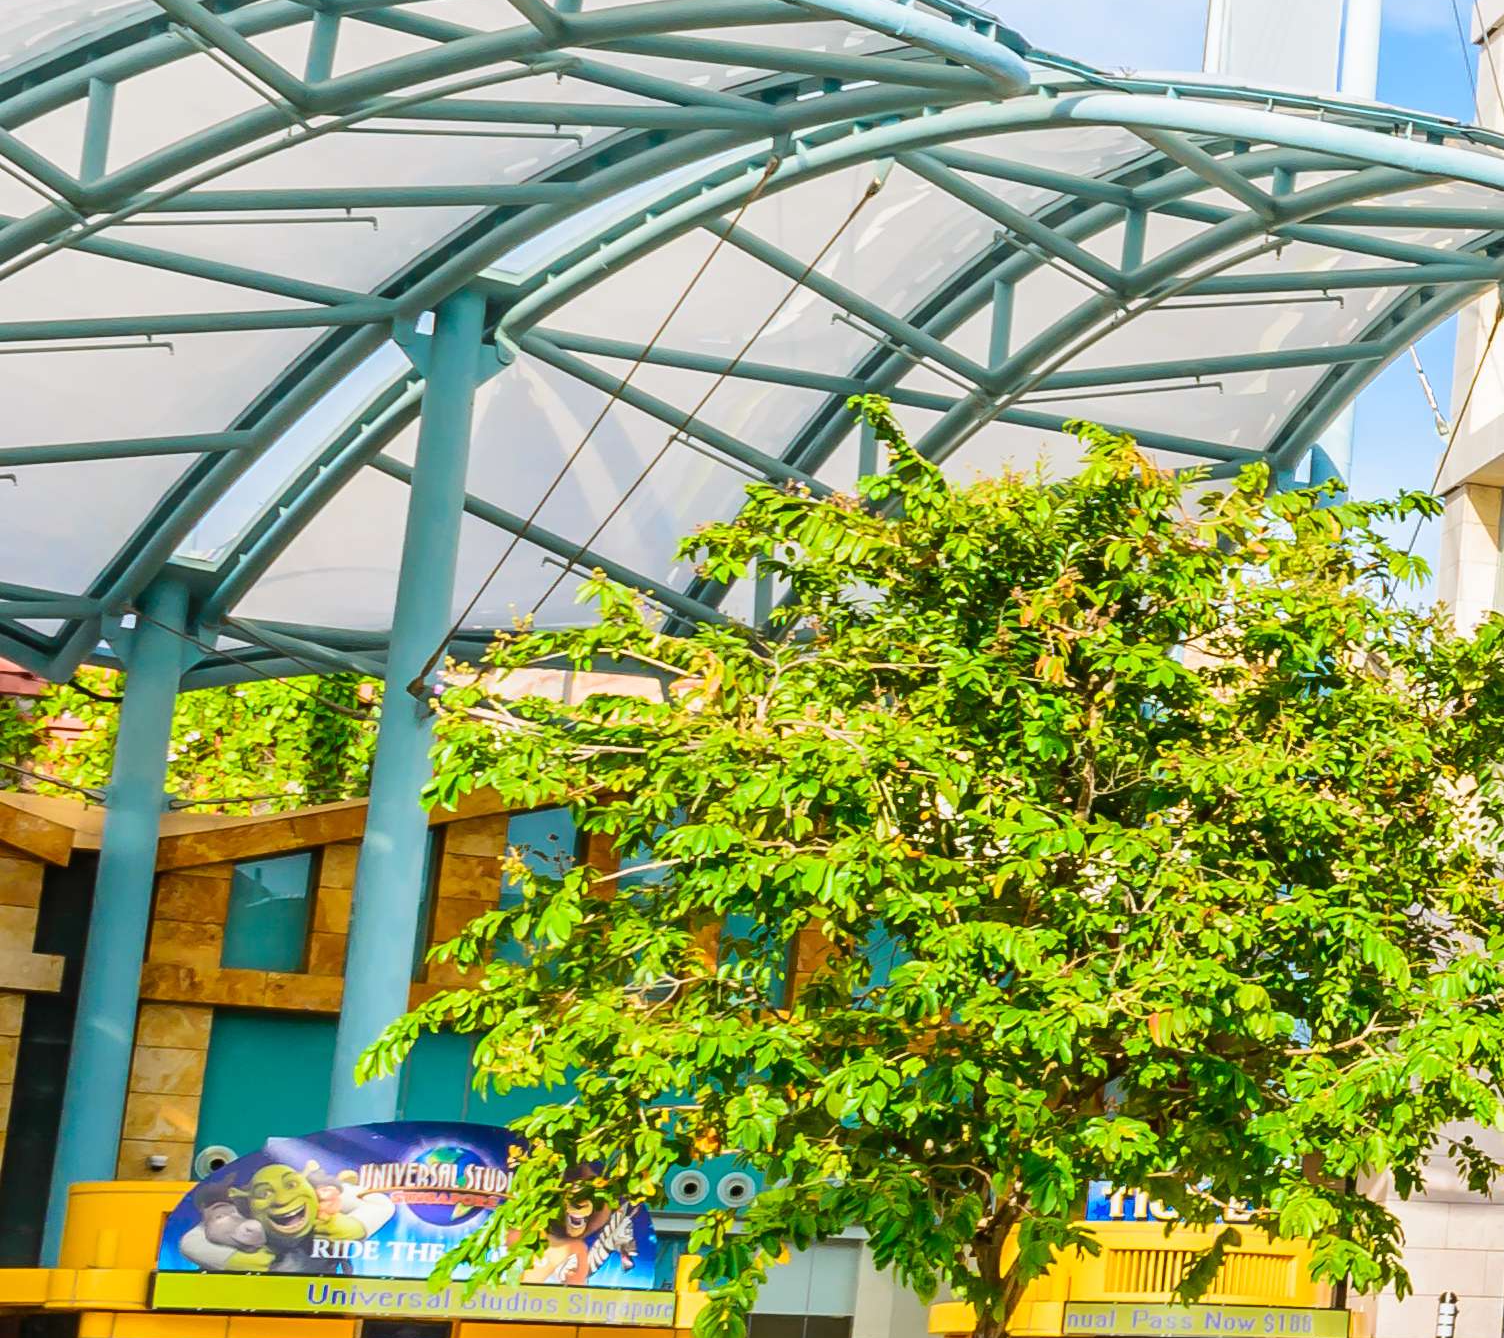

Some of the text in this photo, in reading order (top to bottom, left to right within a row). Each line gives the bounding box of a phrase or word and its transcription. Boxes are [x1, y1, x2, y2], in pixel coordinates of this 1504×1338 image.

[360, 1162, 460, 1189] UNIVERSAL
[311, 1238, 382, 1260] RIDE
[387, 1241, 446, 1263] THE
[308, 1283, 450, 1310] Universal
[1132, 1310, 1192, 1330] Pass
[1205, 1311, 1257, 1331] Now
